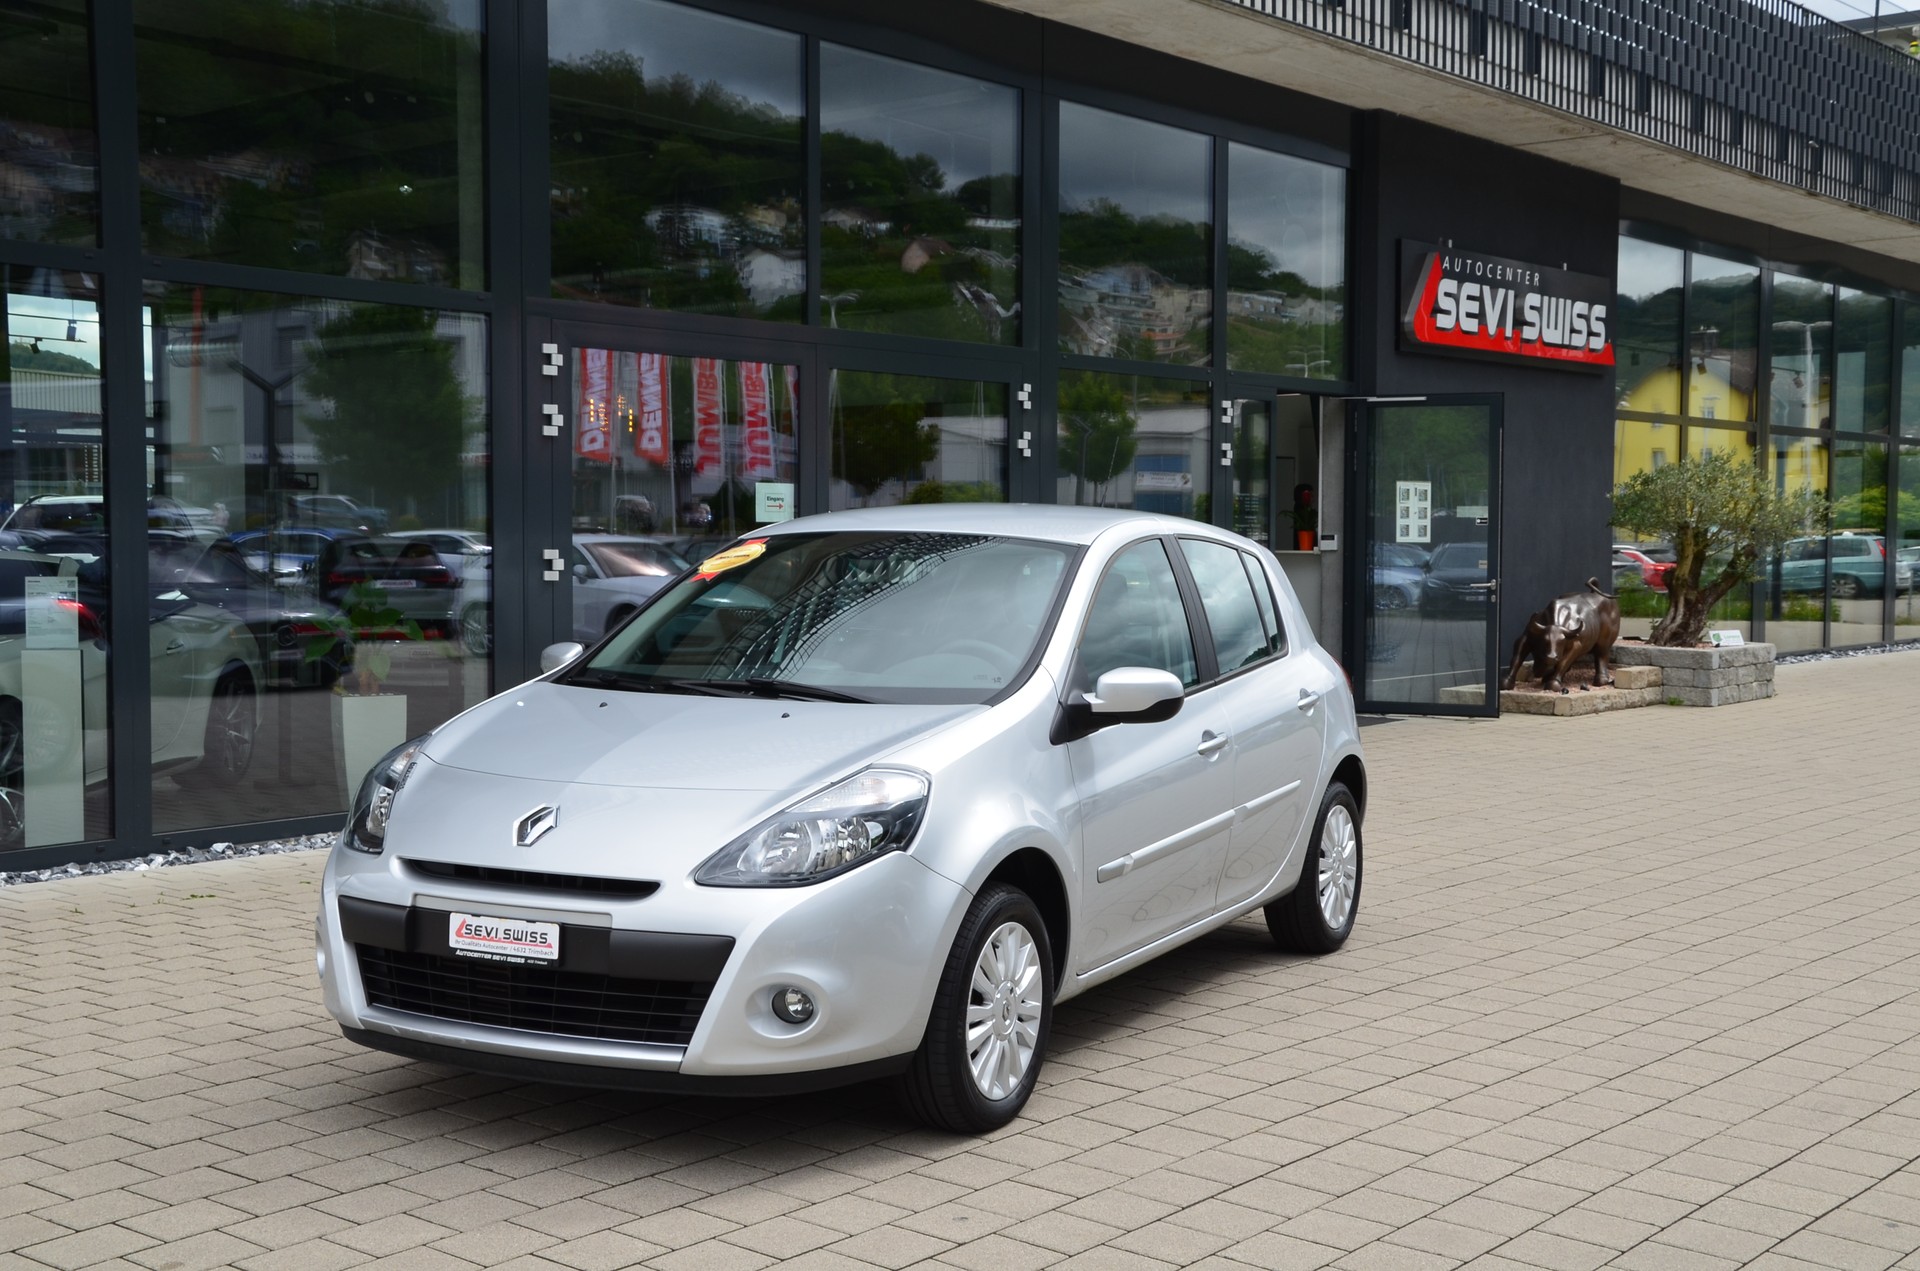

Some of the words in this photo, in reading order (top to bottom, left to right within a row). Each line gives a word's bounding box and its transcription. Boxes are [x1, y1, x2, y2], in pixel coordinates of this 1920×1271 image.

[1442, 256, 1540, 287] AUTOCENTER
[1436, 278, 1515, 337] SEVI
[1522, 292, 1607, 350] SWISS
[766, 495, 785, 503] Eingang
[464, 923, 499, 939] SEVI
[502, 928, 548, 944] SWISS
[482, 942, 509, 951] Autocenter
[528, 948, 554, 957] Trimbach
